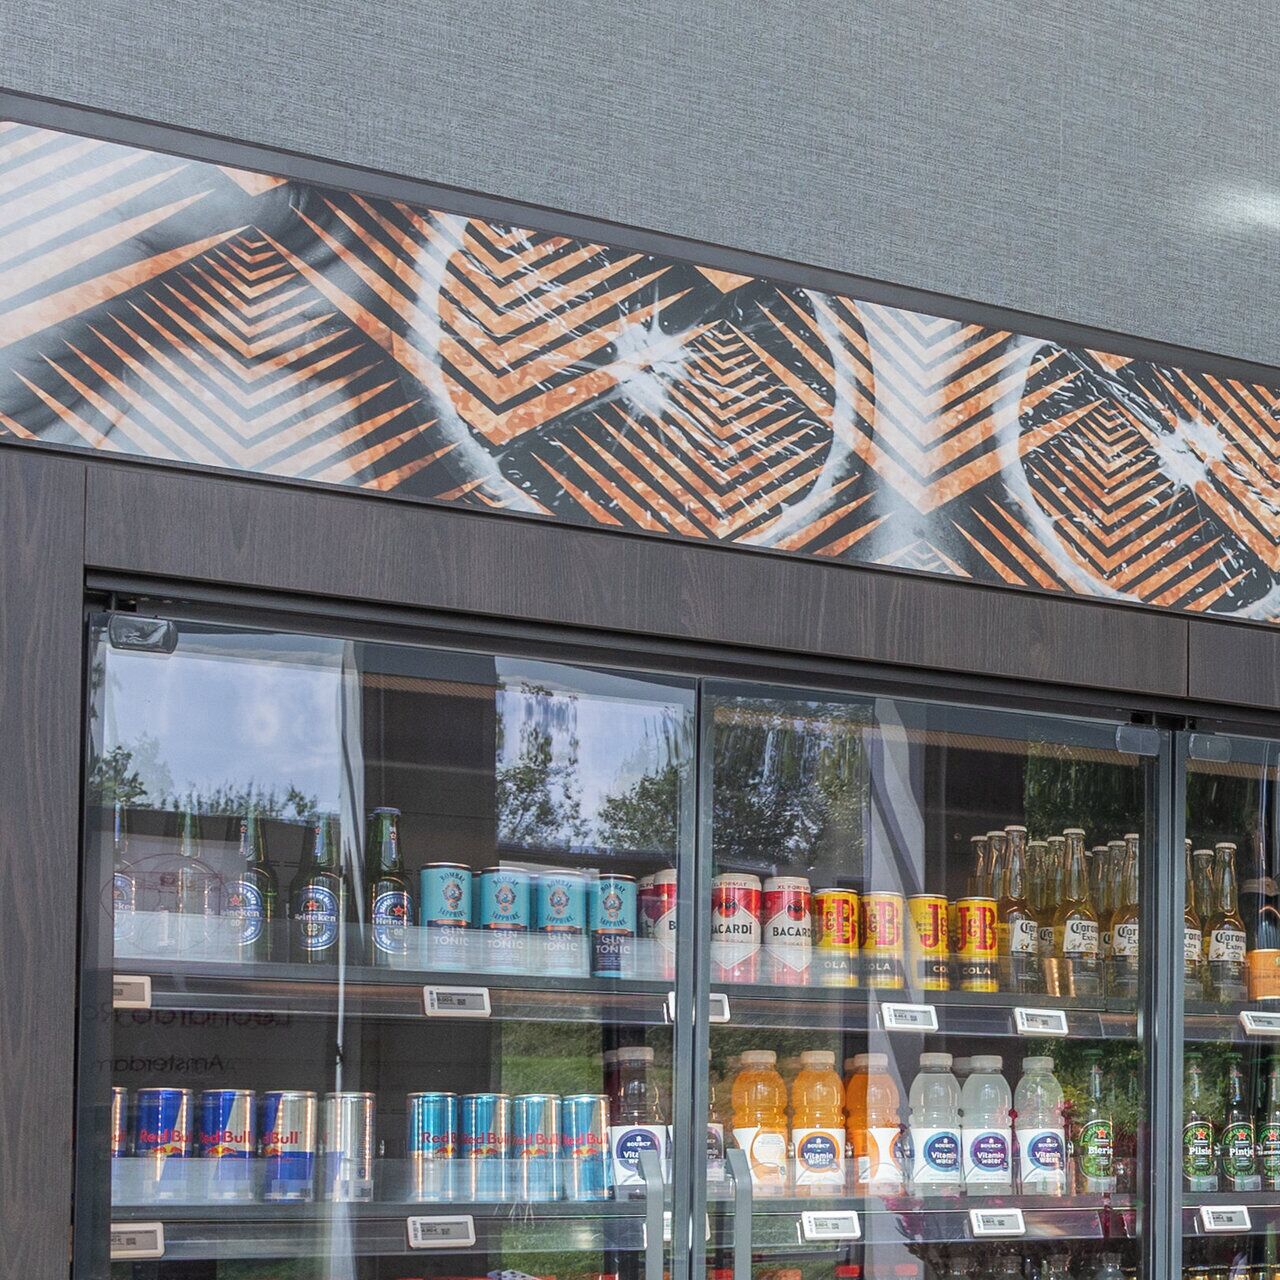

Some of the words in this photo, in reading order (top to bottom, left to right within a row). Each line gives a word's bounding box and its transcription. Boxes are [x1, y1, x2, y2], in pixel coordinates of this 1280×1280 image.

[441, 926, 465, 935] GIN
[956, 906, 997, 950] J&B
[493, 929, 518, 939] GIN
[548, 932, 572, 941] GIN
[433, 936, 470, 946] TONIC
[487, 939, 524, 950] TONIC
[601, 935, 625, 945] GIN
[542, 942, 579, 952] TONIC
[595, 945, 631, 955] TONIC
[962, 966, 992, 975] COLA
[270, 1130, 299, 1145] Bull
[802, 1152, 834, 1161] Vitamin
[930, 1151, 957, 1160] Vitamin
[976, 1151, 1005, 1160] Vitamin
[1033, 1151, 1061, 1160] Vitamin
